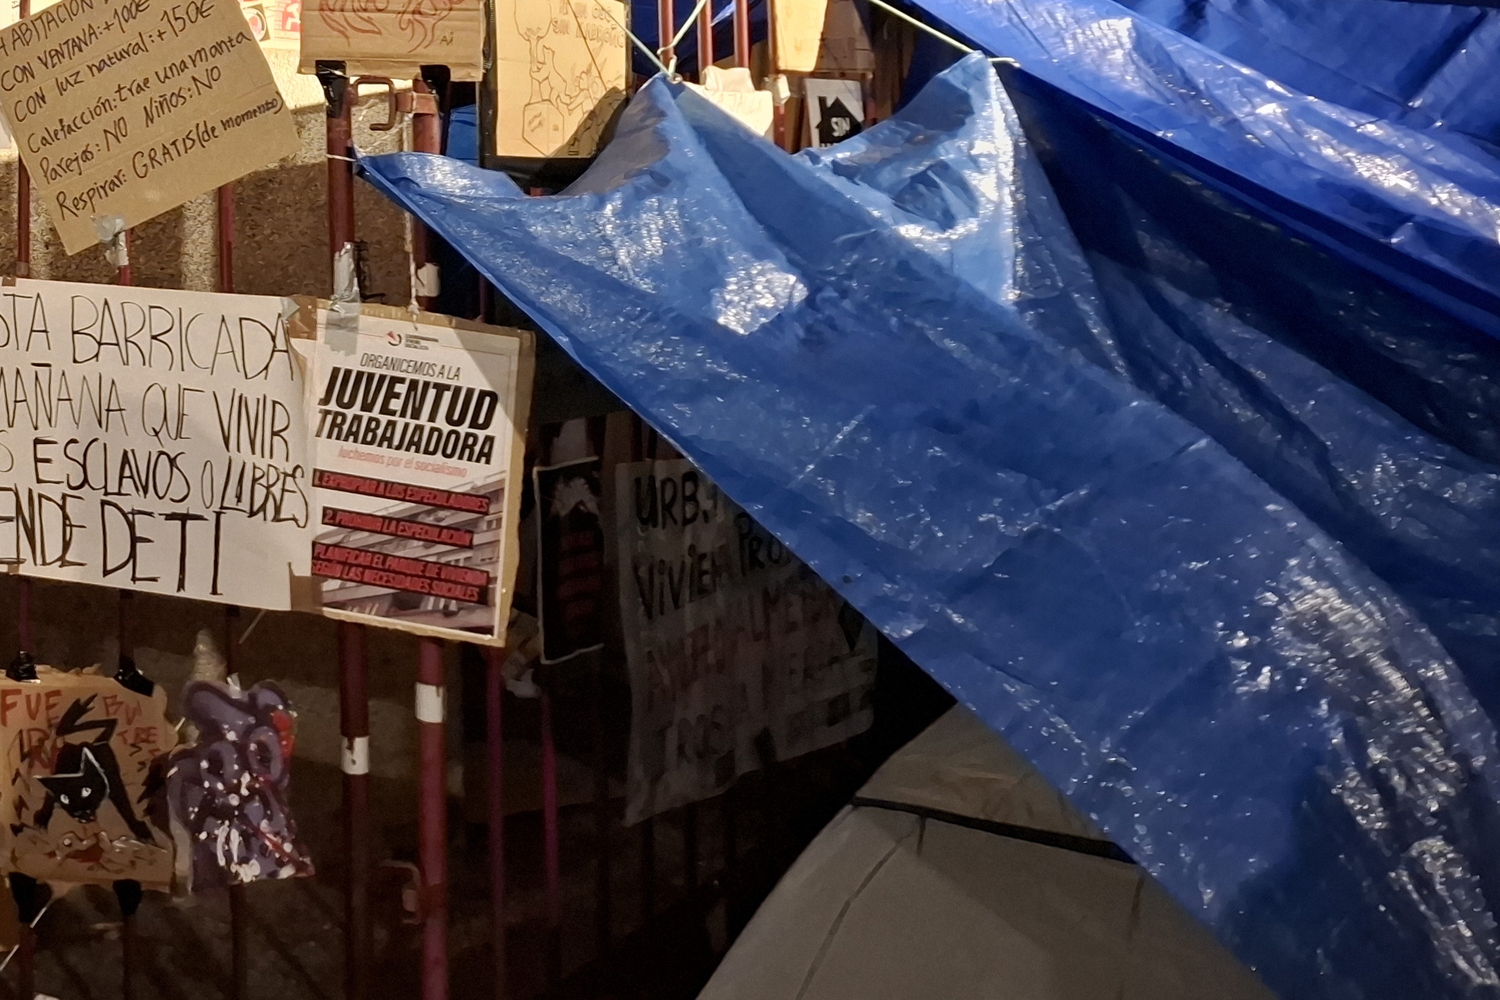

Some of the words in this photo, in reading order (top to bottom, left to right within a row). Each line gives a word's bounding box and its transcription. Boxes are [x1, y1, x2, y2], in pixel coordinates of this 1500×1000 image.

[0, 63, 36, 93] CON
[13, 90, 47, 123] CON
[103, 117, 129, 152] NO
[191, 65, 222, 97] NO
[70, 294, 296, 382] BARRICADA
[359, 352, 437, 377] ORGANICEMOS
[437, 364, 446, 380] A
[446, 366, 462, 381] LA
[141, 382, 204, 449] QUE
[318, 366, 498, 431] JUVENTUD
[315, 409, 495, 465] TRABAJADORA
[33, 437, 191, 503] ESCLAVOS
[201, 459, 214, 509] O
[218, 457, 309, 529] LIBRES
[100, 498, 160, 584] DE
[159, 506, 225, 596] TI
